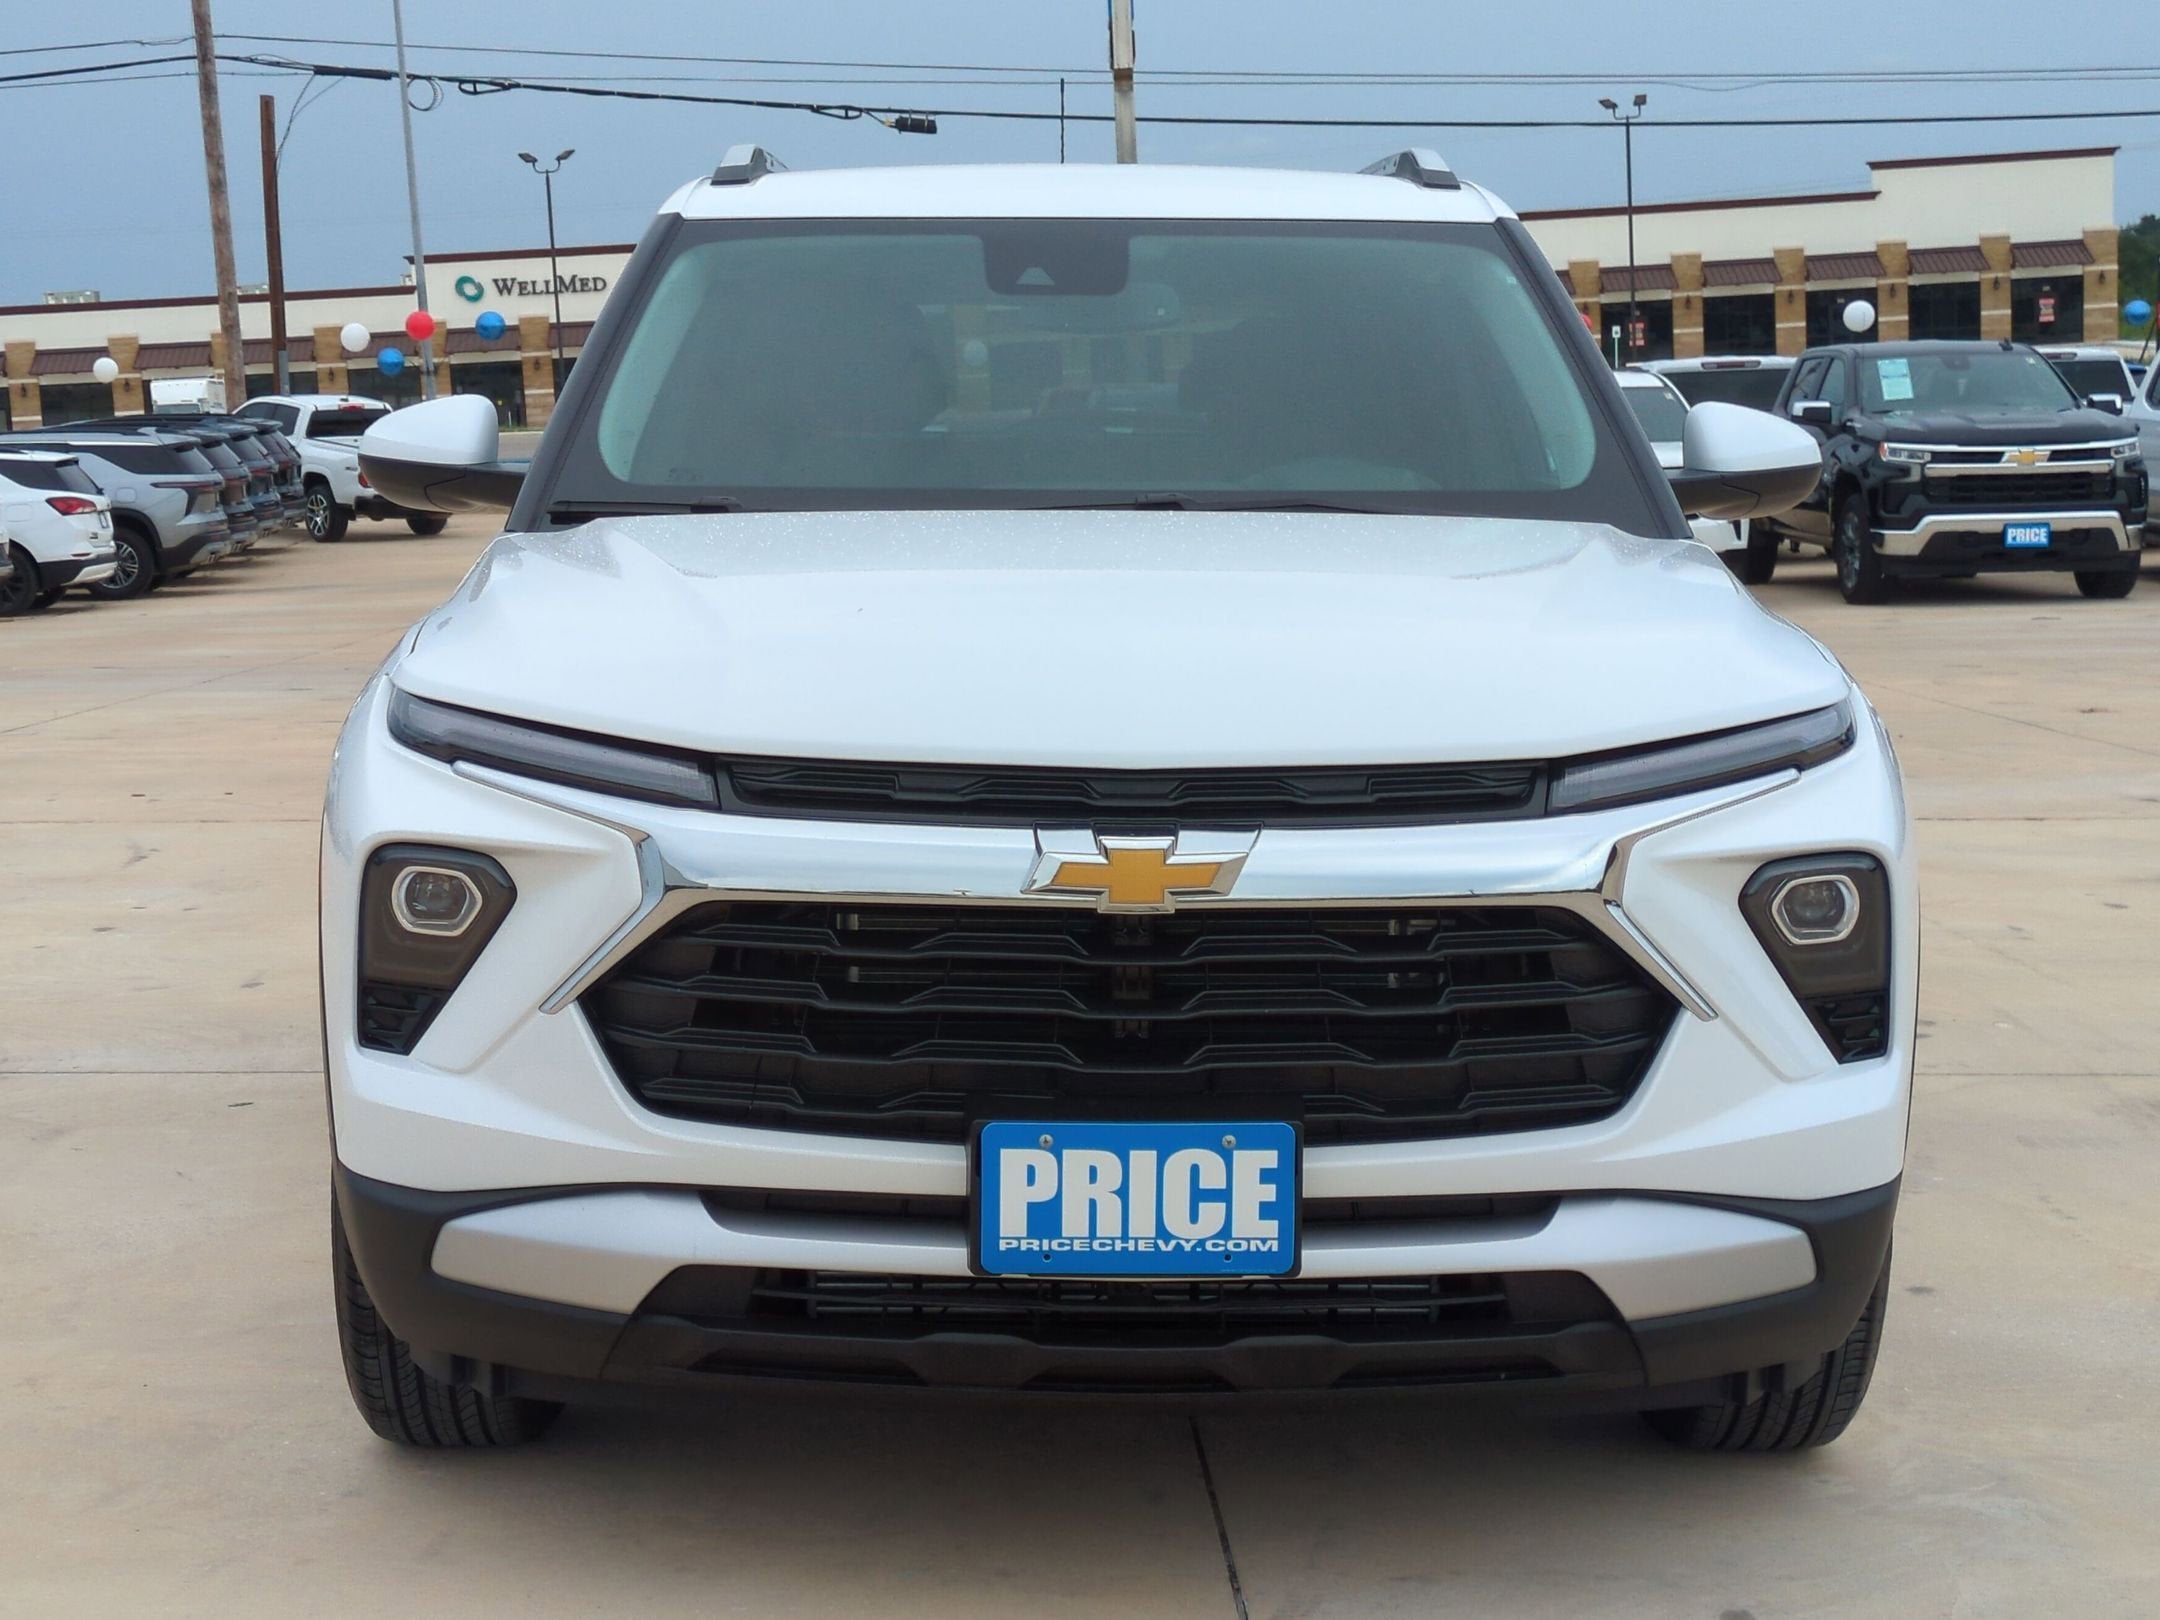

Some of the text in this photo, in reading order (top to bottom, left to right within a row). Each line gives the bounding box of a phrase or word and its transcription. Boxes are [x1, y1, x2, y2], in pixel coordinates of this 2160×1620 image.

[2007, 528, 2048, 542] PRICE
[999, 1148, 1279, 1238] PRICE
[999, 1238, 1279, 1252] PRICECHEVY.COM
